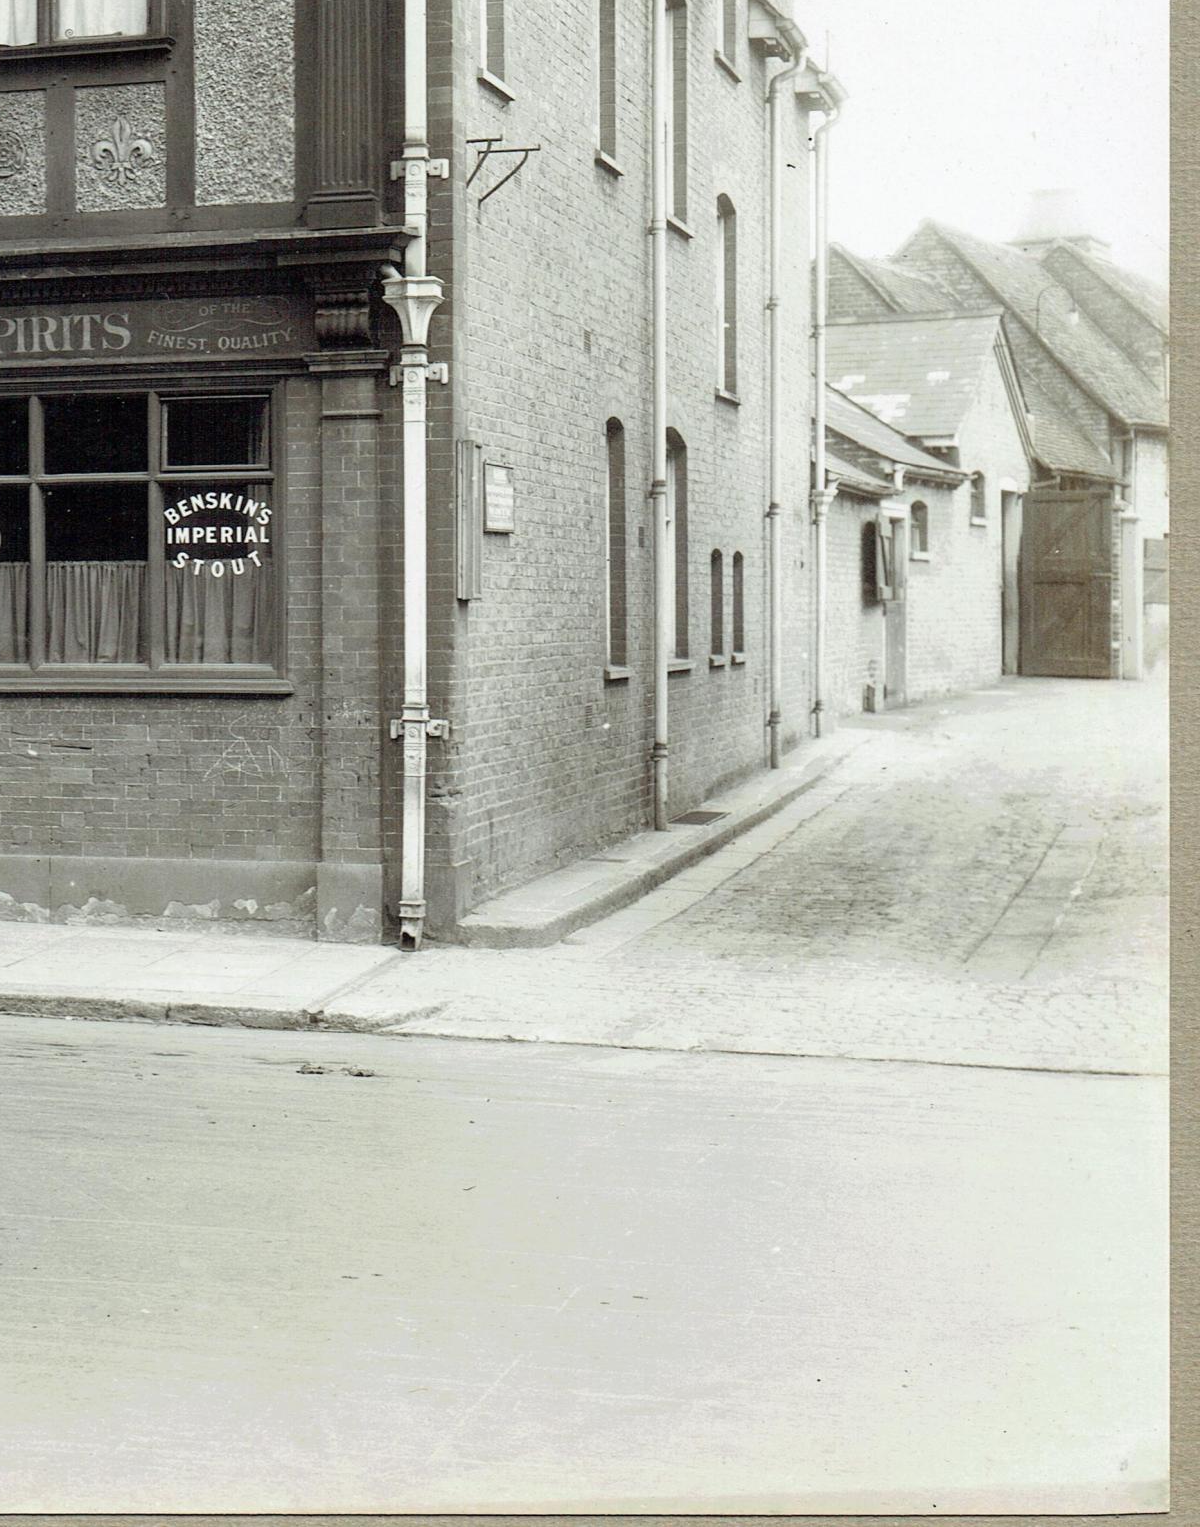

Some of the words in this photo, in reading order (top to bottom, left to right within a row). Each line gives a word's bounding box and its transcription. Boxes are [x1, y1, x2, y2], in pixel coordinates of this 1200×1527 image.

[199, 304, 217, 316] OF
[221, 303, 251, 314] THE
[147, 330, 209, 350] FINEST
[163, 492, 273, 525] BENSKIN'S
[166, 526, 270, 544] IMPERIAL
[172, 550, 262, 578] STOUT
